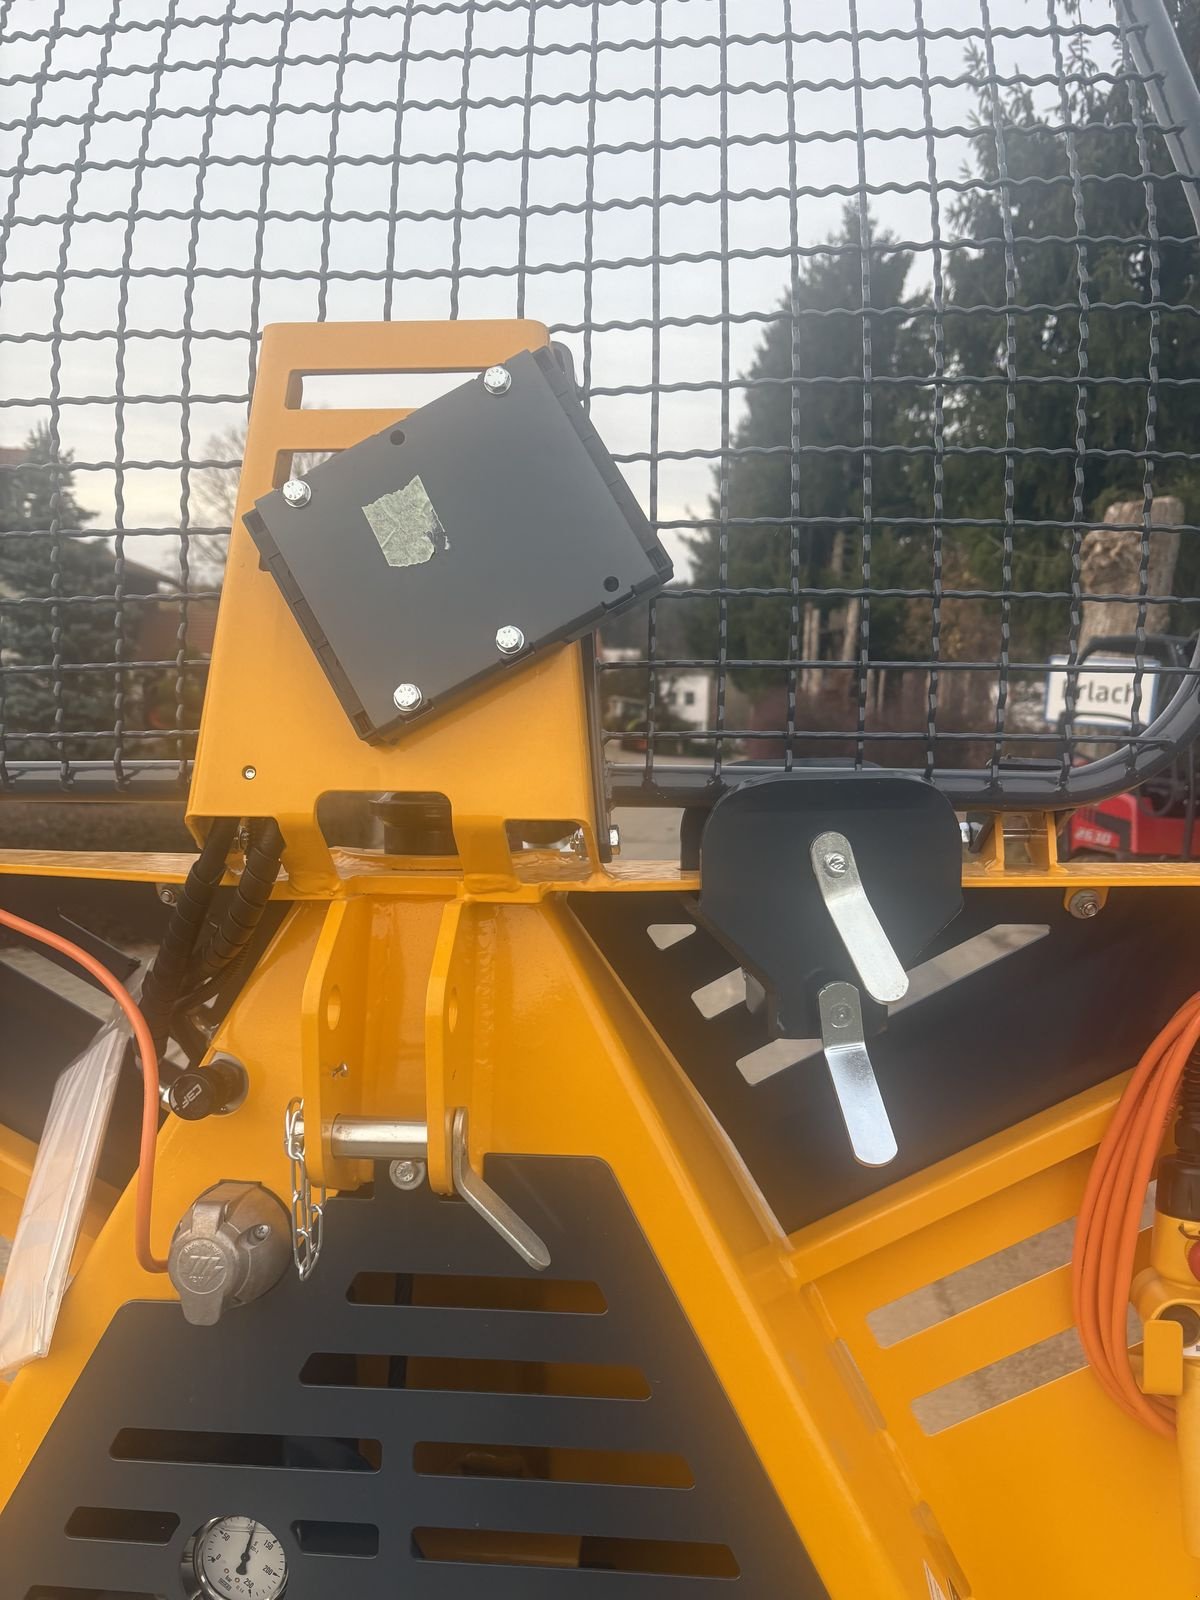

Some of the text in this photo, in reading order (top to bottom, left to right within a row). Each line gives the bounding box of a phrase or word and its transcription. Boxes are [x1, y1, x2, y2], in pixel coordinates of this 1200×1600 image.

[222, 1532, 231, 1541] 50
[263, 1539, 274, 1551] 150
[262, 1564, 274, 1576] 200
[243, 1577, 255, 1589] 250
